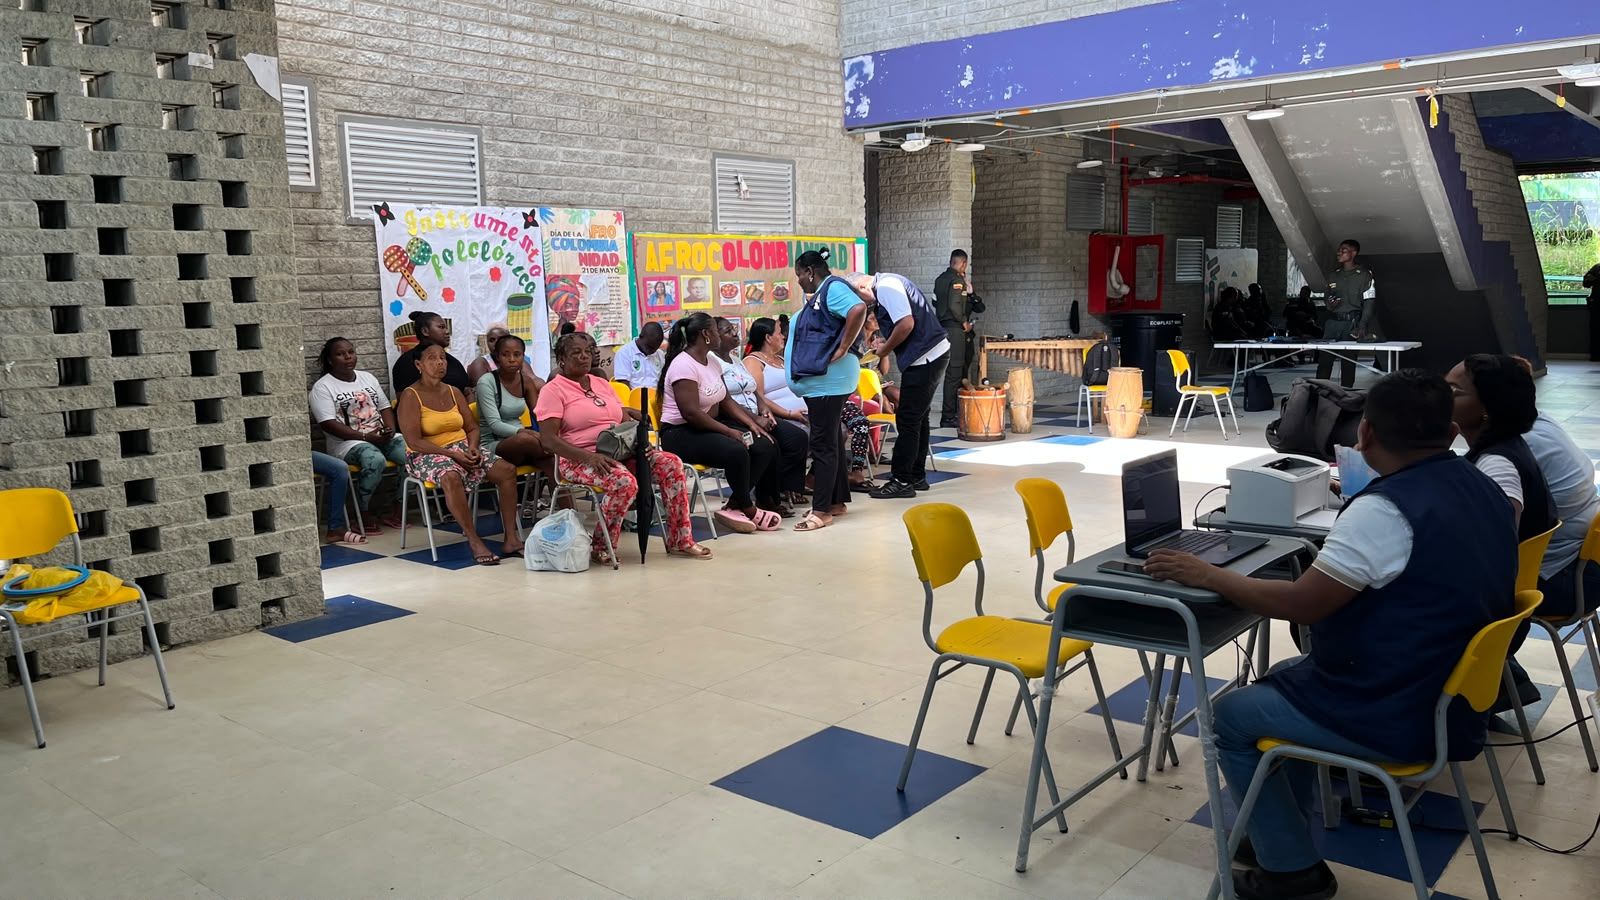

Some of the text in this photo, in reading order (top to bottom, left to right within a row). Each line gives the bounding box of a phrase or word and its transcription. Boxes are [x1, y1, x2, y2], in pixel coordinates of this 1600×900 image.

[550, 229, 562, 237] DÍA
[551, 237, 618, 251] COLOMBIA
[578, 253, 619, 267] NIDAD
